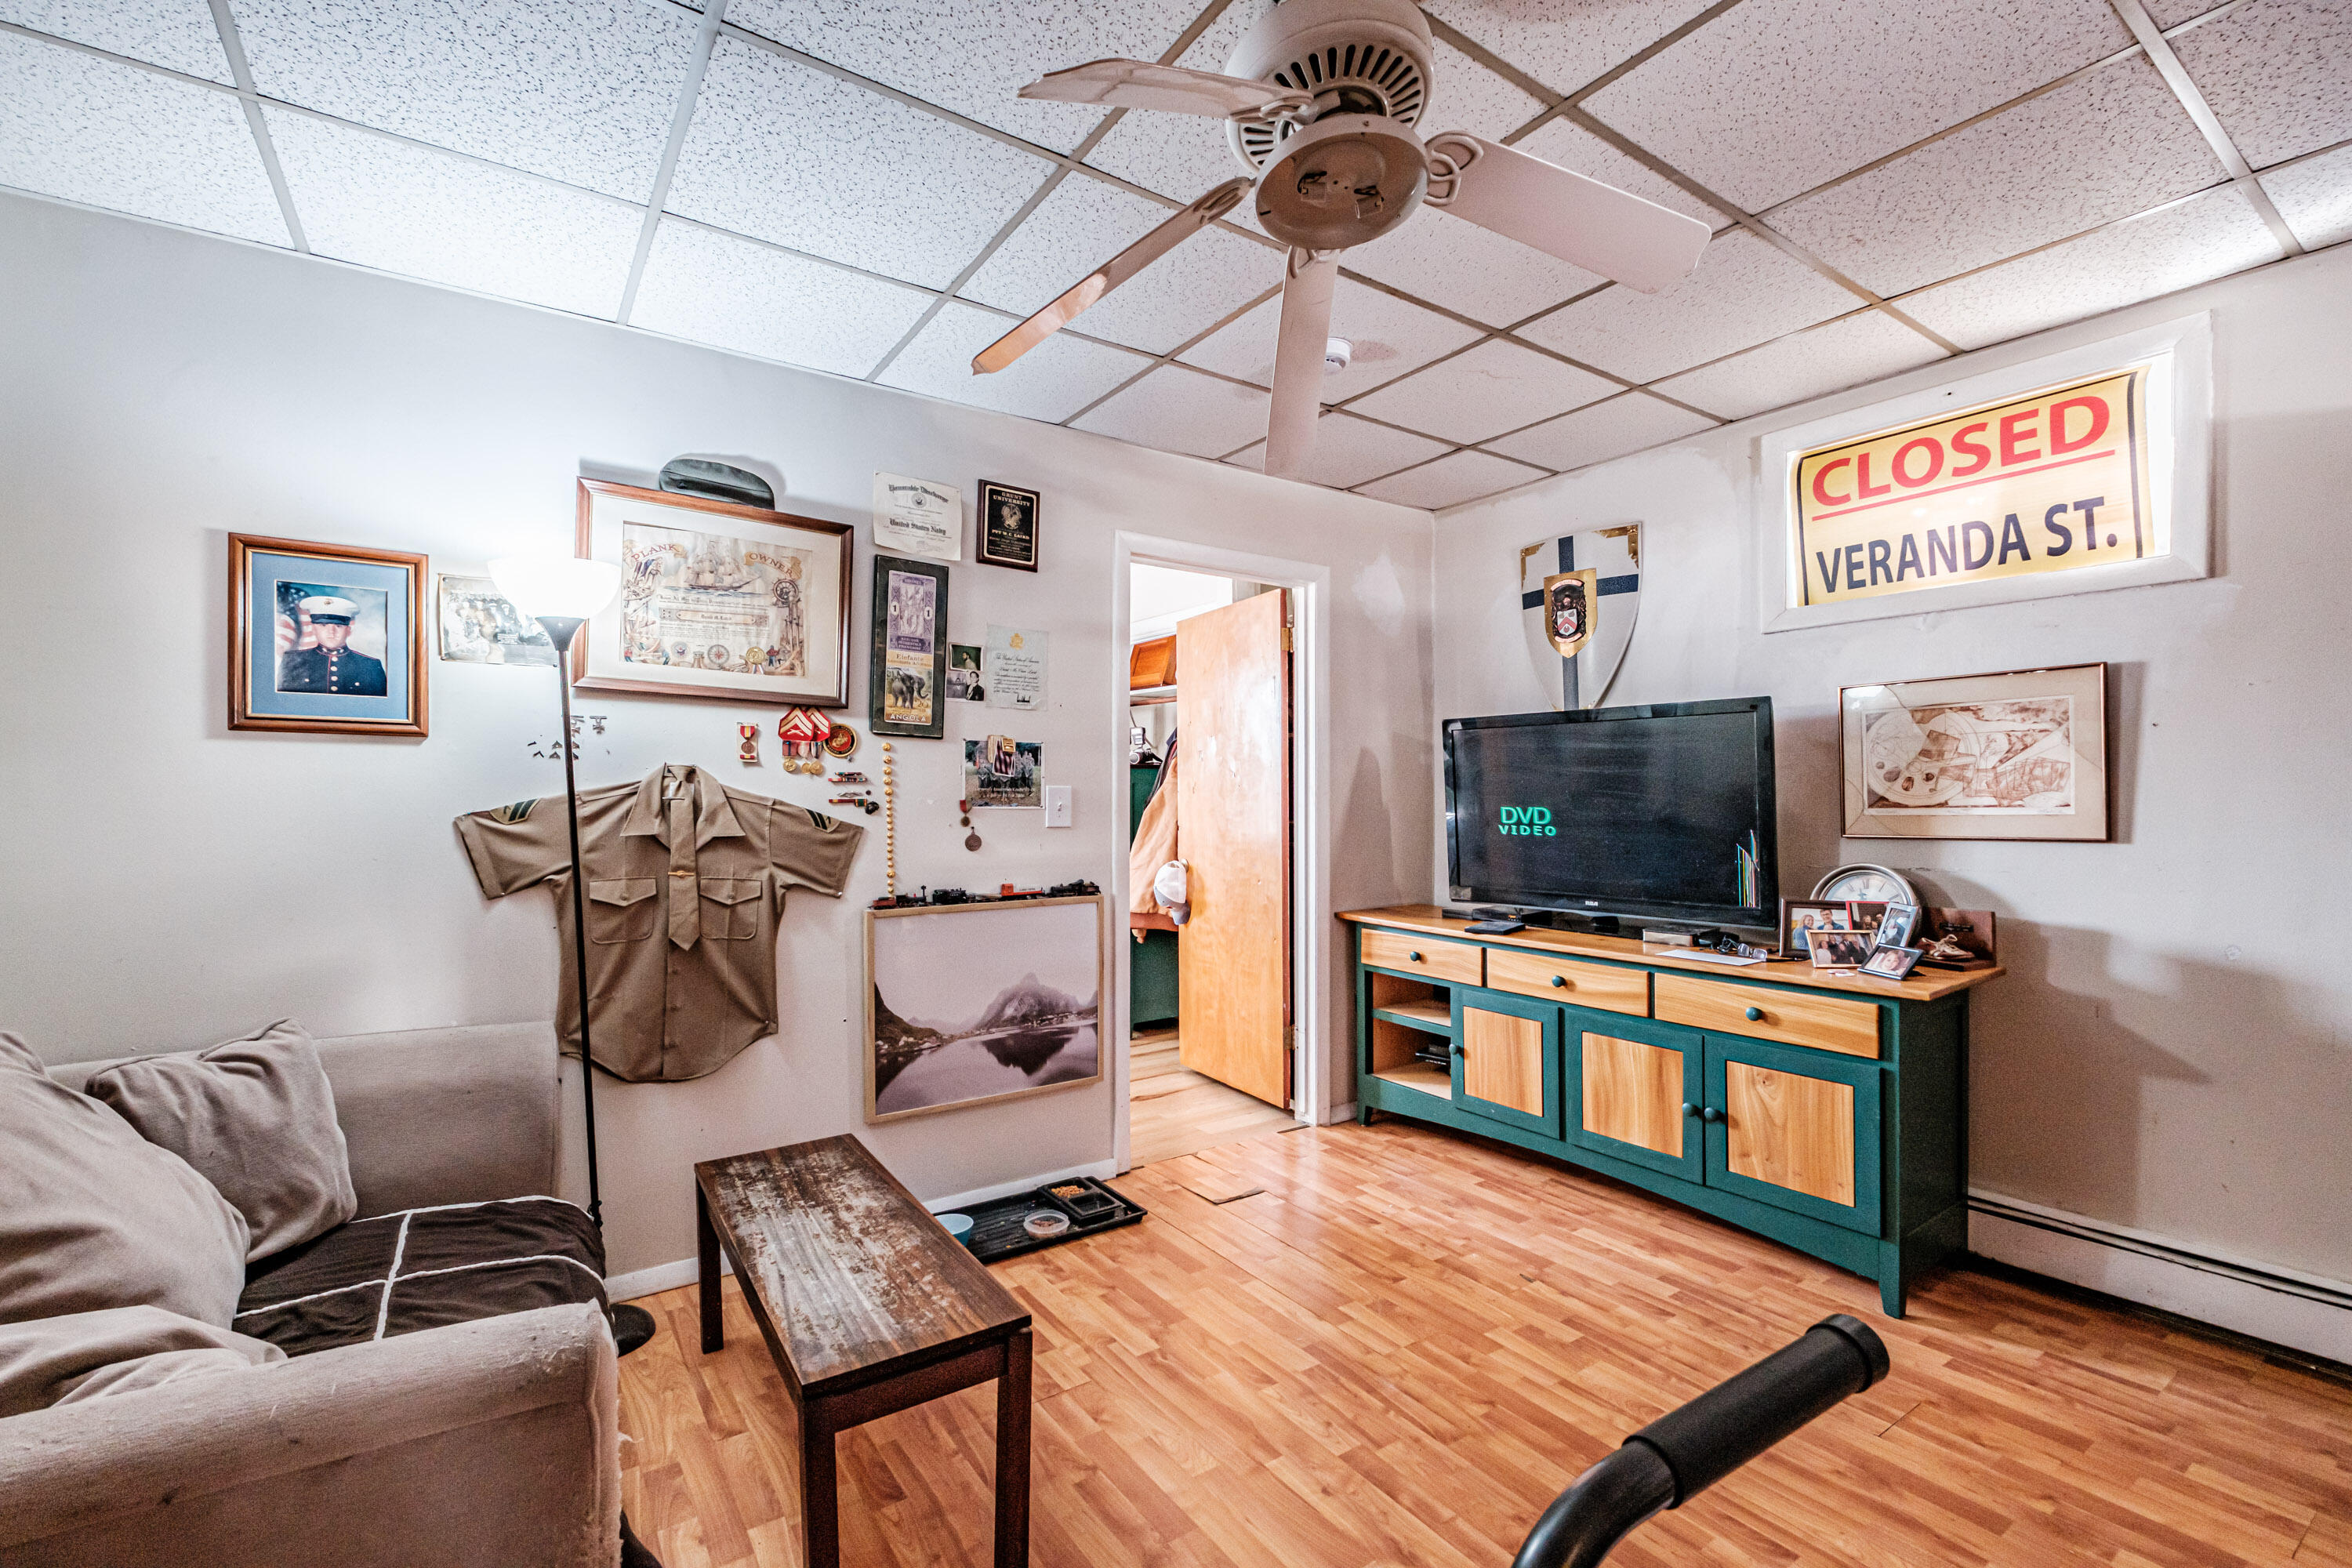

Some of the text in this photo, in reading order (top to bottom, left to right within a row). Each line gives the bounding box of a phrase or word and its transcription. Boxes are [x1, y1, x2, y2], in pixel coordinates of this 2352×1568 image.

[1813, 396, 2111, 506] CLOSED
[993, 495, 1031, 507] UNIVERSITY
[1001, 492, 1023, 500] GRUNT
[889, 518, 910, 528] United
[911, 522, 931, 532] States
[630, 543, 680, 562] PLANK
[1816, 495, 2119, 594] VERANDA ST.
[749, 552, 795, 578] OWNER
[890, 713, 926, 722] ANGOLA
[1500, 806, 1552, 824] DVD
[1498, 824, 1556, 836] VIDEO
